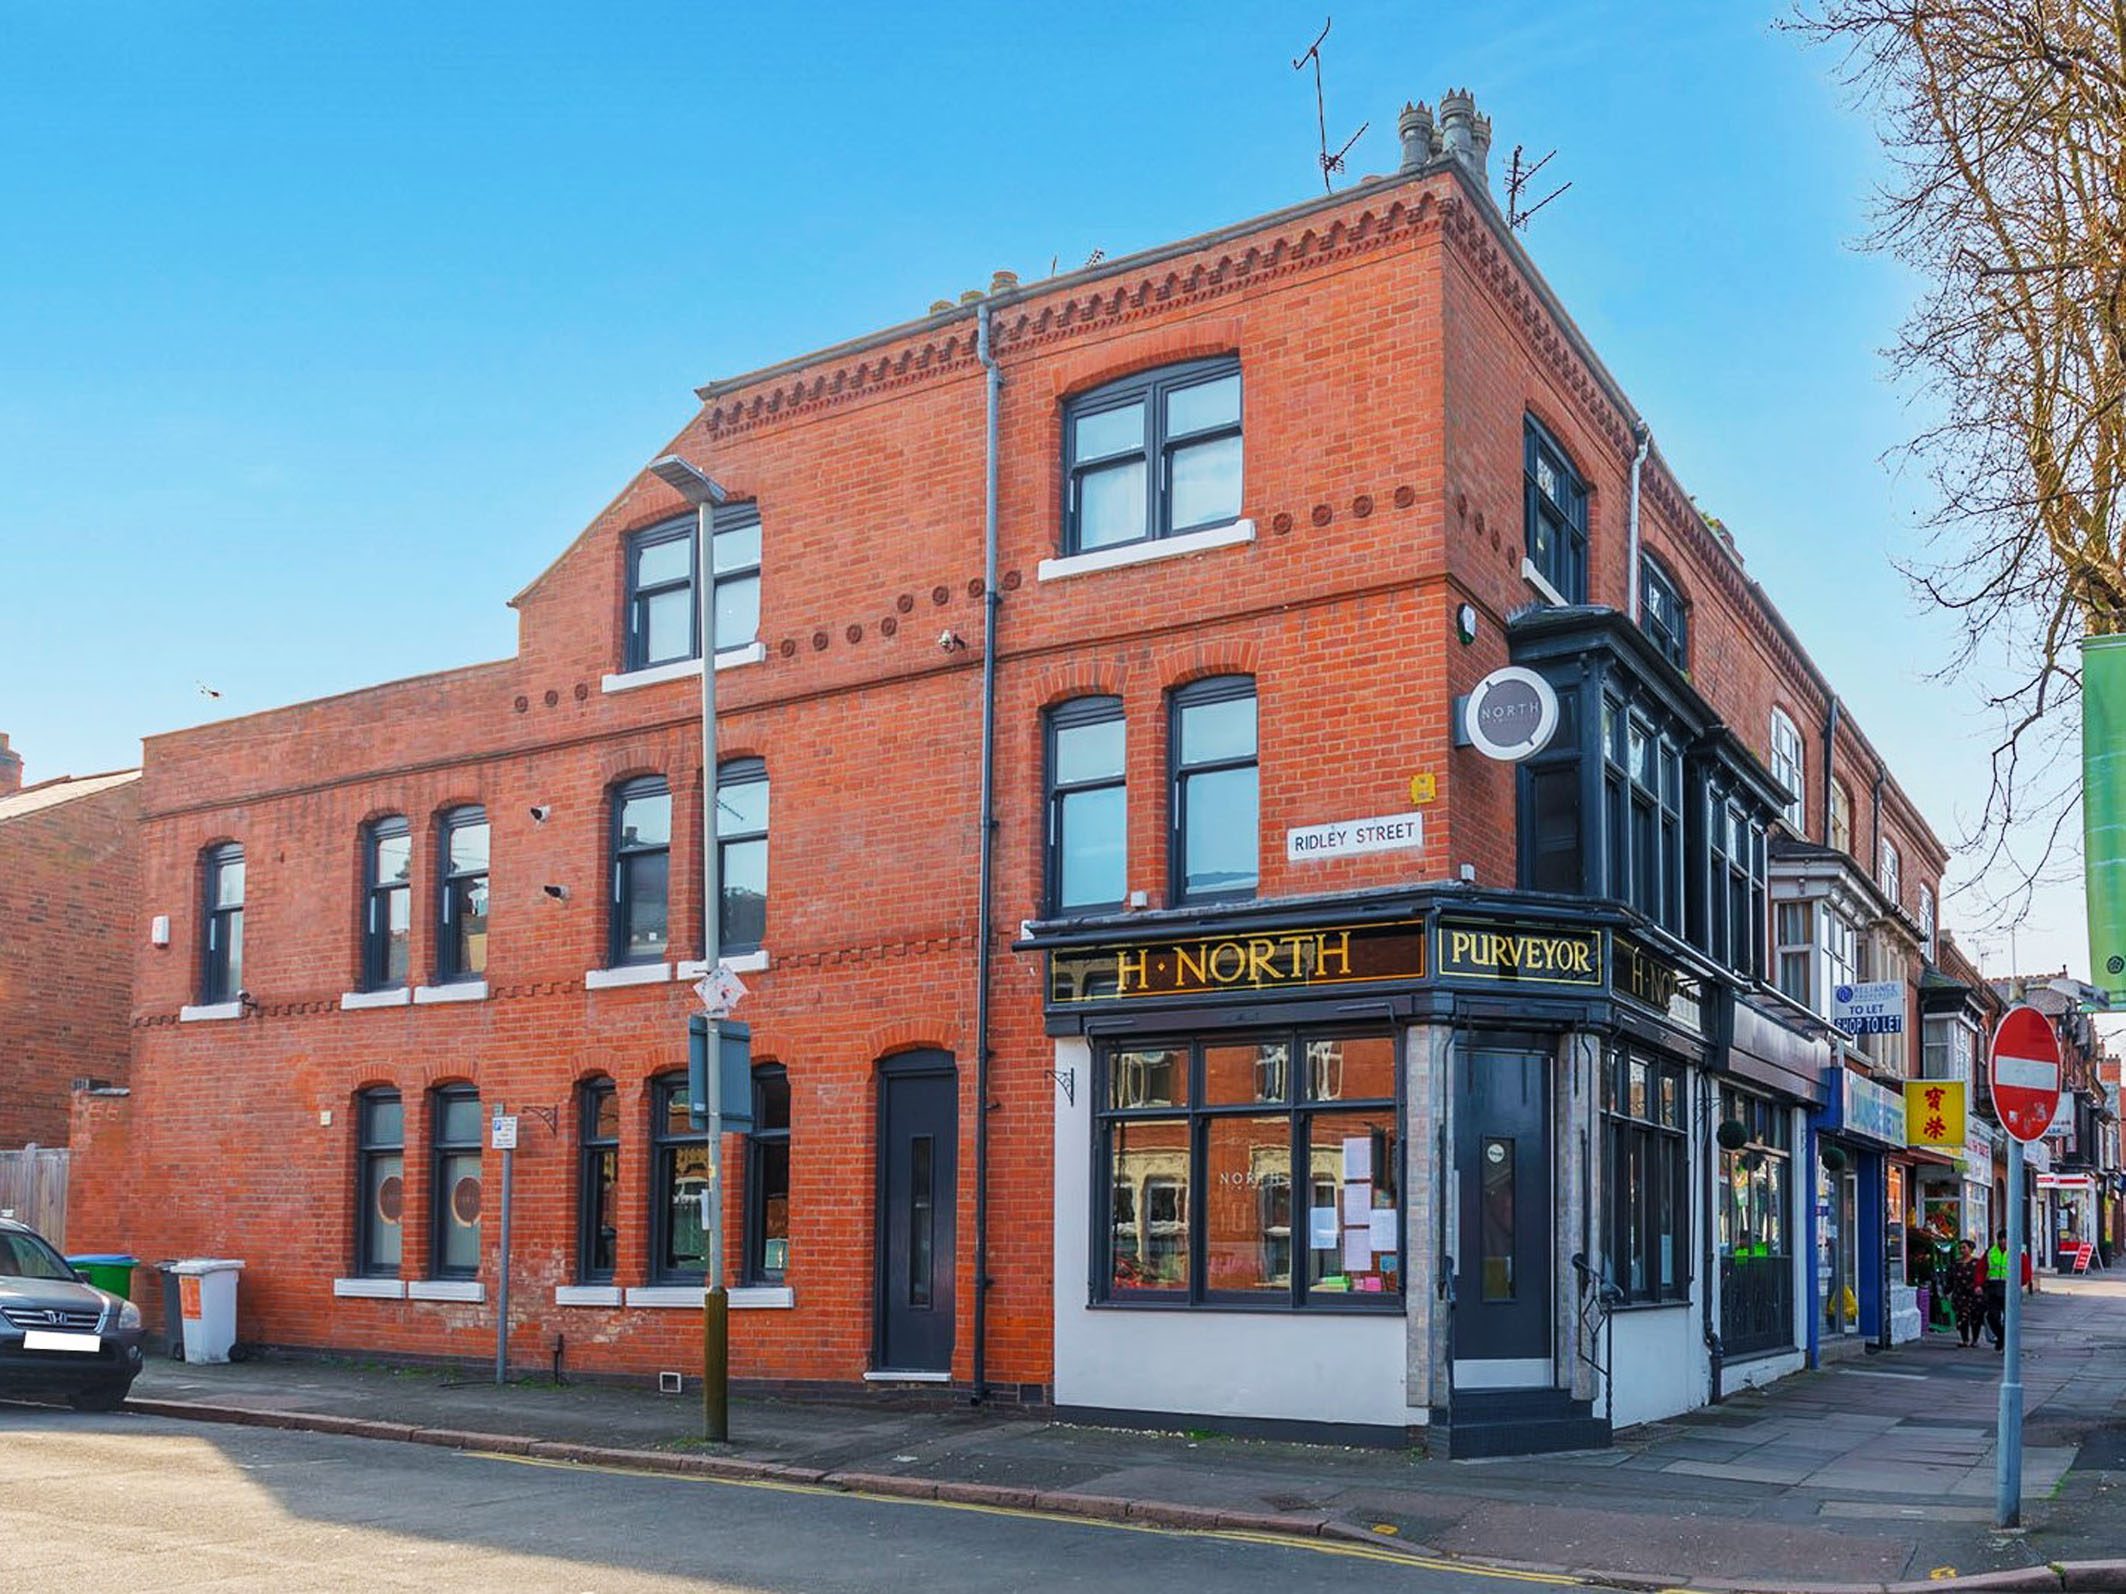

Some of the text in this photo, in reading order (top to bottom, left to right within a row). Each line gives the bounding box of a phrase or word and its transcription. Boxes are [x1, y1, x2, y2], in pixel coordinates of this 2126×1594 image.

[1481, 701, 1539, 719] NORTH
[1294, 822, 1414, 851] RIDLEY STREET
[1173, 931, 1352, 986] NORTH
[1451, 931, 1592, 973] PURVEYOR
[1849, 1003, 1884, 1015] TO LET
[1836, 1016, 1901, 1034] SHOP TO LET
